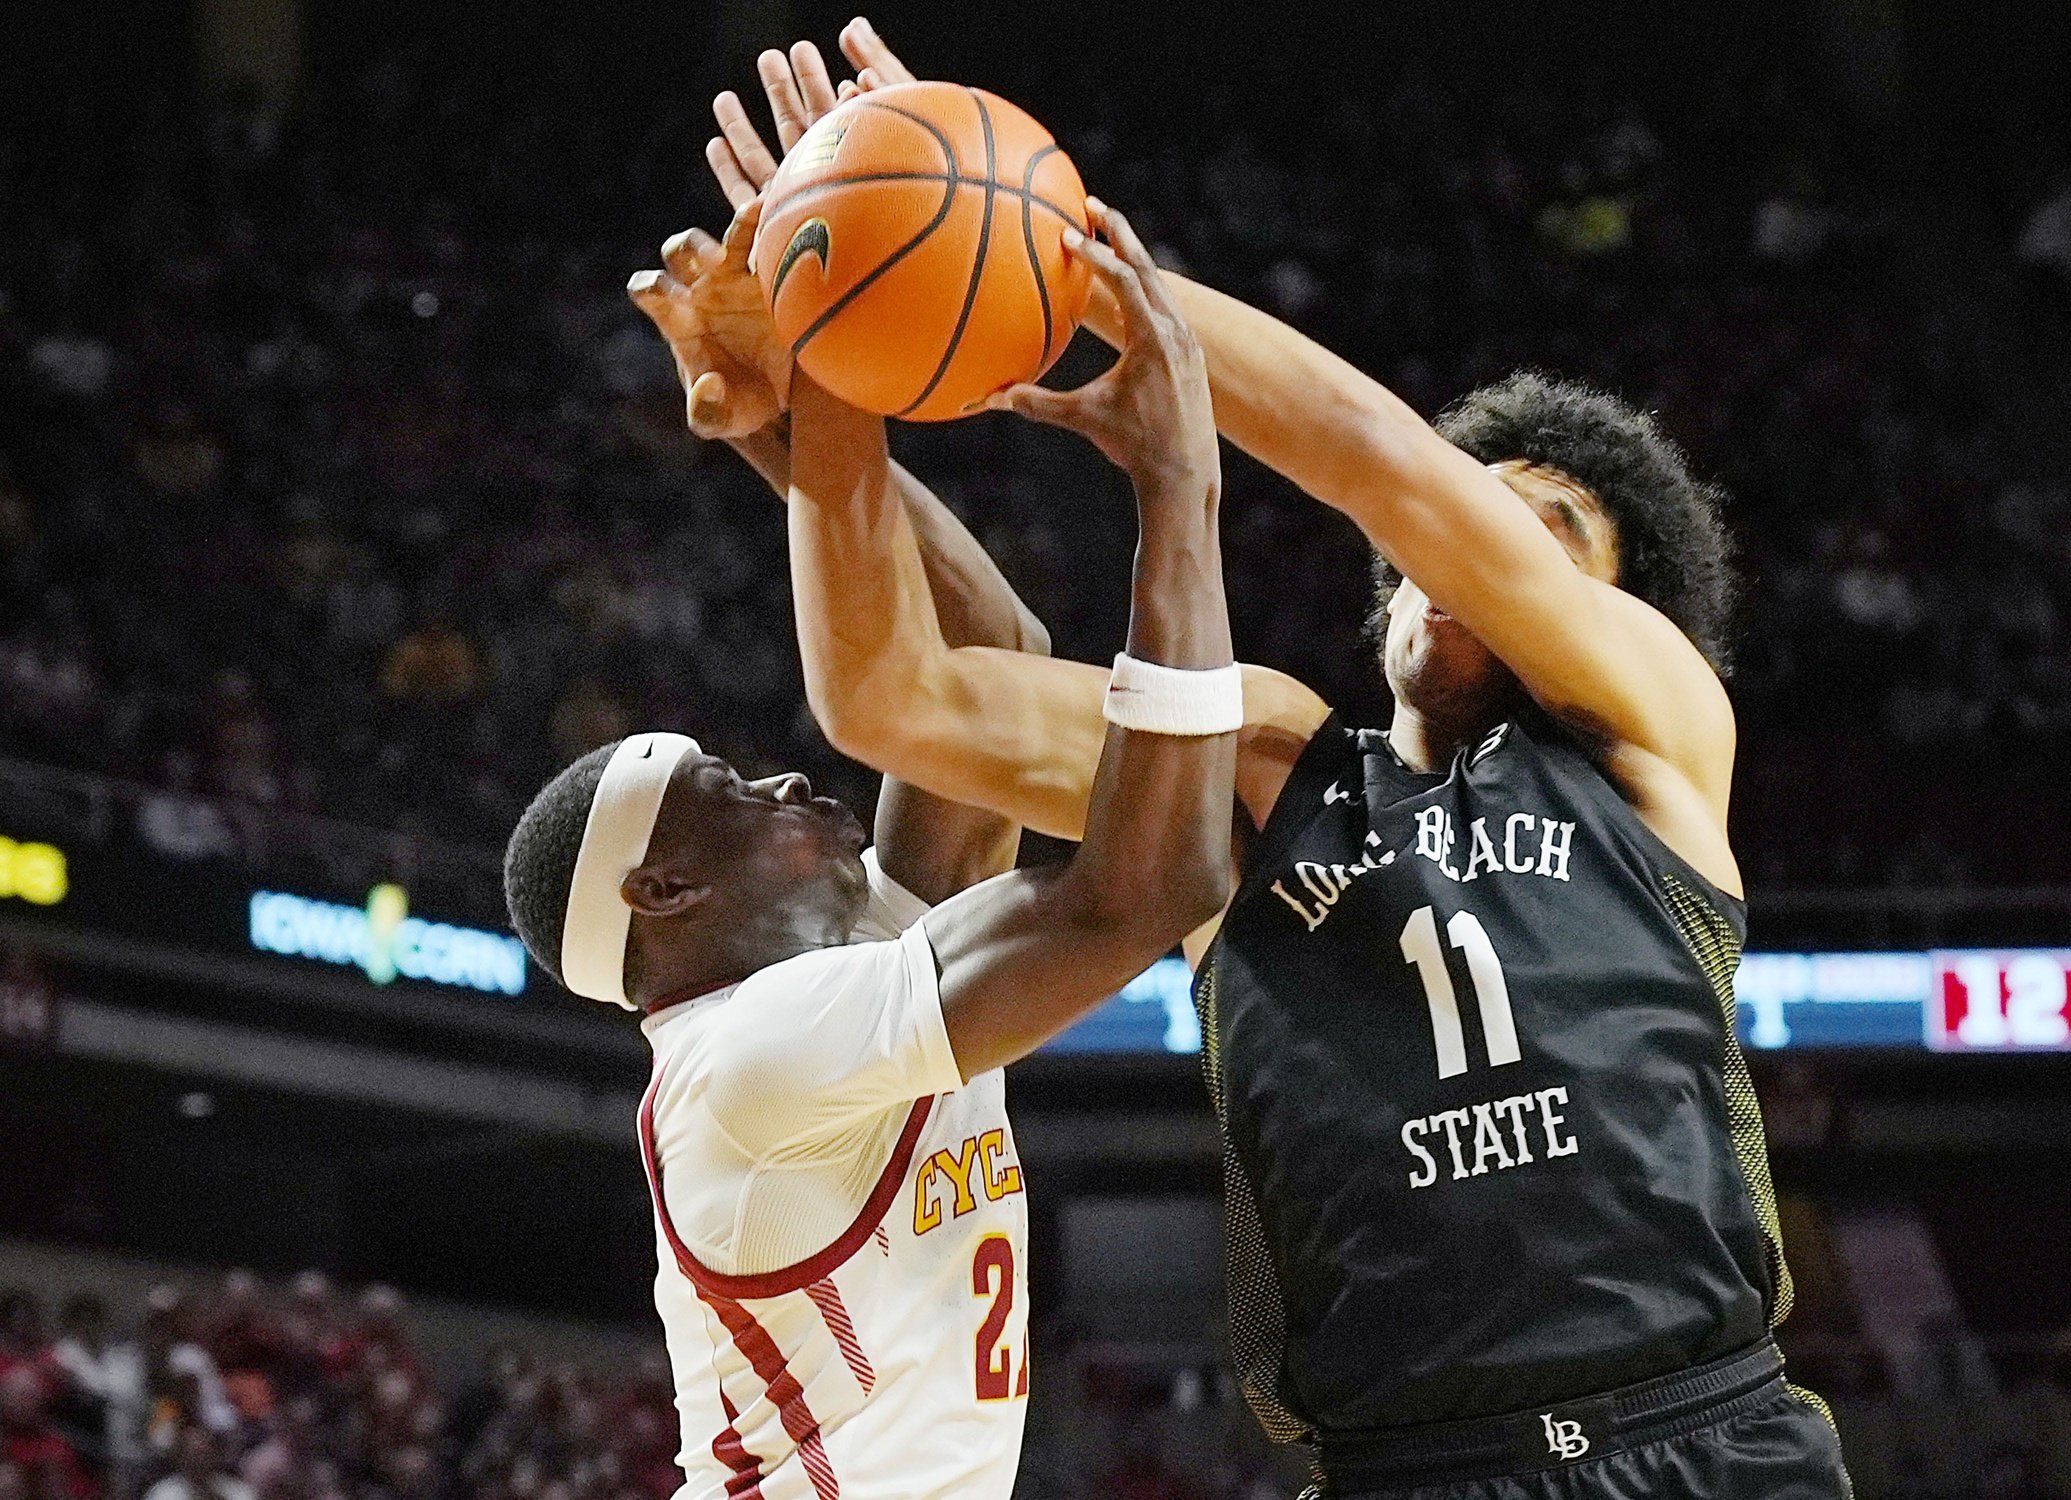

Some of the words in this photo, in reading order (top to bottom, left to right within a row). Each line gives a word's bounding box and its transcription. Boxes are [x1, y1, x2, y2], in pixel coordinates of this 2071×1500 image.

[1414, 805, 1576, 882] BEACH
[1399, 905, 1522, 1080] 11
[1956, 956, 2069, 1046] 12
[1401, 1086, 1579, 1189] STATE
[971, 1232, 1029, 1401] 2
[1539, 1413, 1590, 1460] LB
